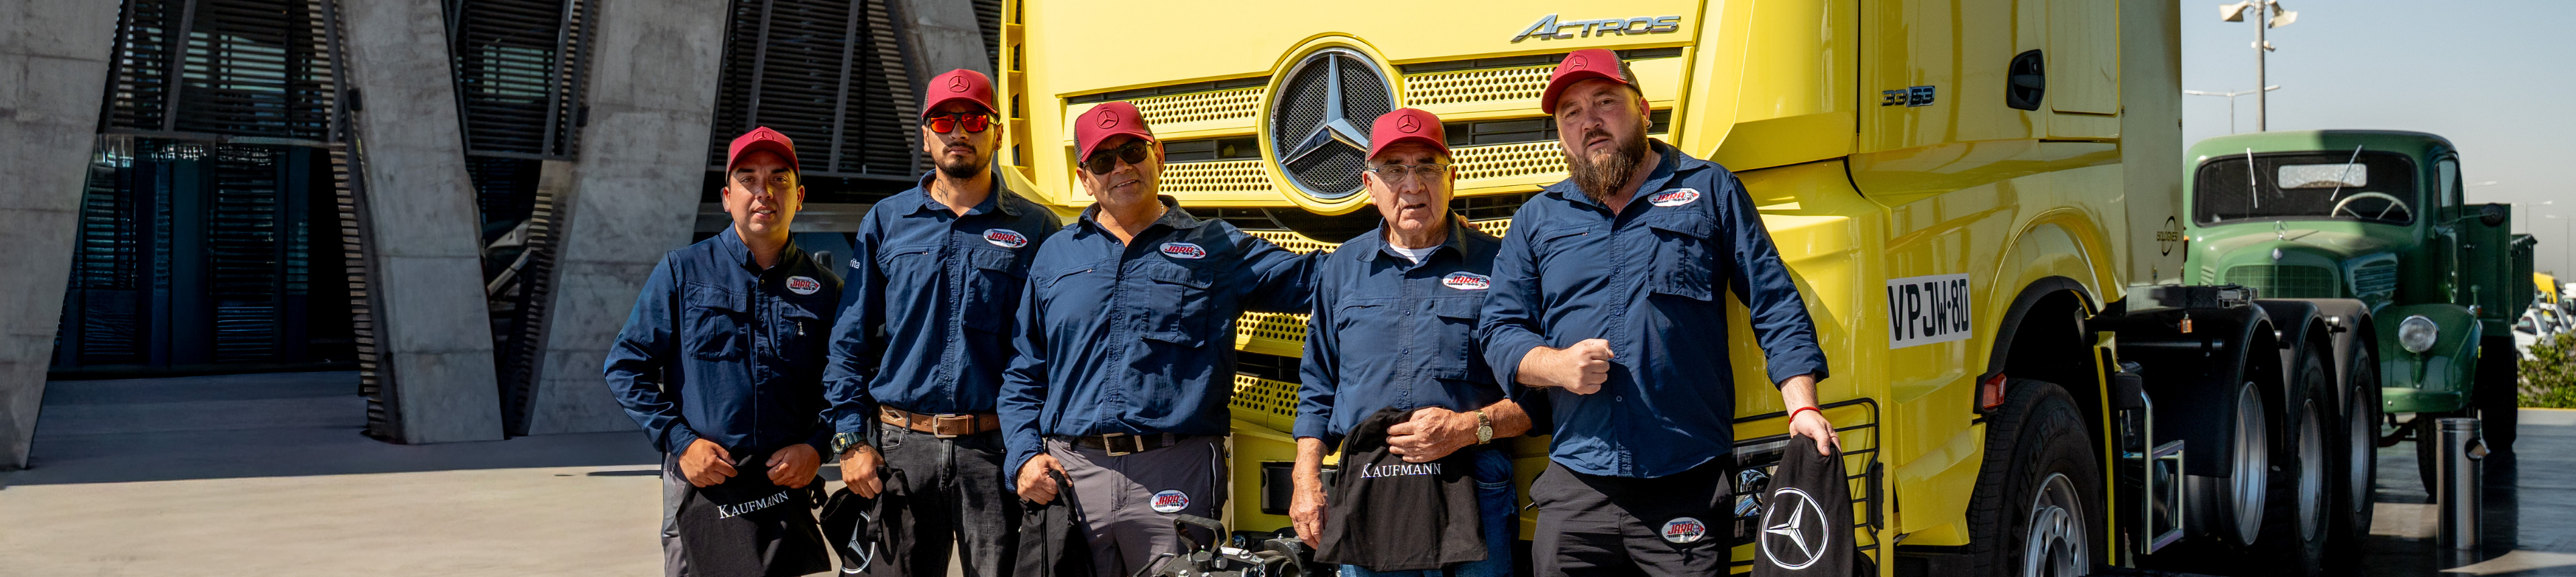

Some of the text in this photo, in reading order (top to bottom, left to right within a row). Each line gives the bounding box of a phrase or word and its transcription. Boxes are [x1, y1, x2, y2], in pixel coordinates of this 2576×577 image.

[1653, 192, 1686, 201] JARA
[987, 232, 1016, 242] JARA
[790, 280, 810, 288] JARA
[1360, 463, 1441, 478] KAUFMANN
[717, 490, 789, 519] KAUFMANN
[1155, 495, 1179, 505] JARA
[1668, 523, 1693, 534] JARA
